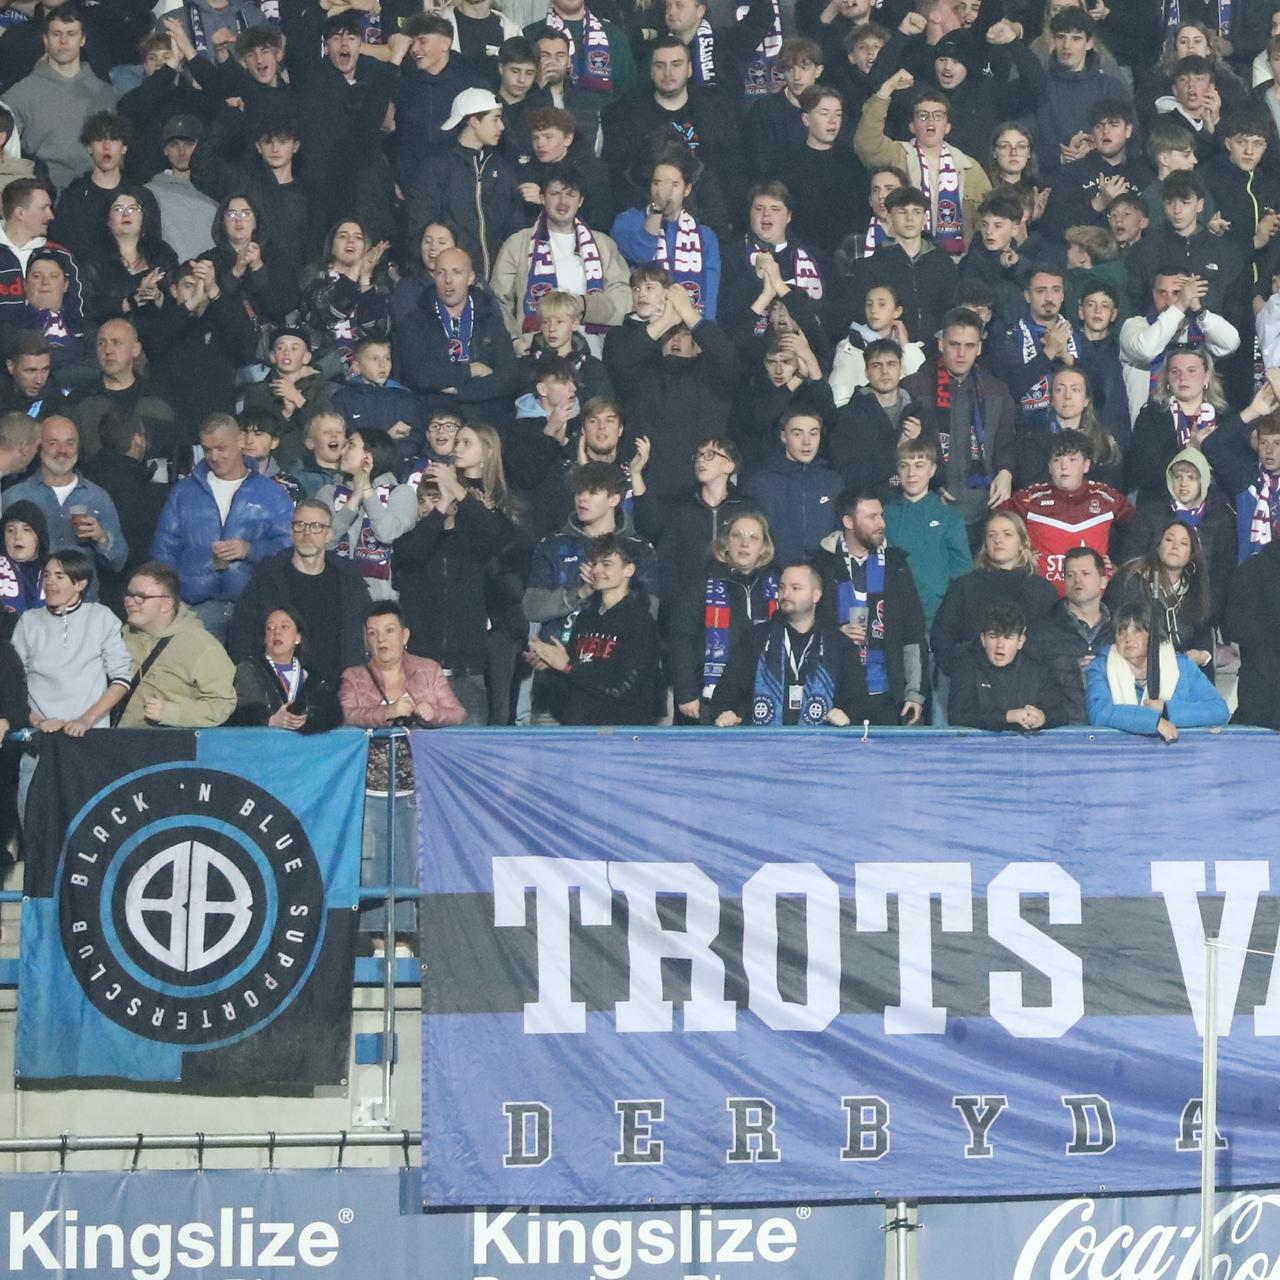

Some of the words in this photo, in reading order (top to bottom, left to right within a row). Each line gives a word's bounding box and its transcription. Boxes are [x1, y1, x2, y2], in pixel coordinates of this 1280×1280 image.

[71, 790, 151, 887] BLACK
[238, 797, 304, 874] BLUE
[71, 904, 310, 1030] SUPPORTERSCLUB
[493, 856, 1085, 1039] TROTS
